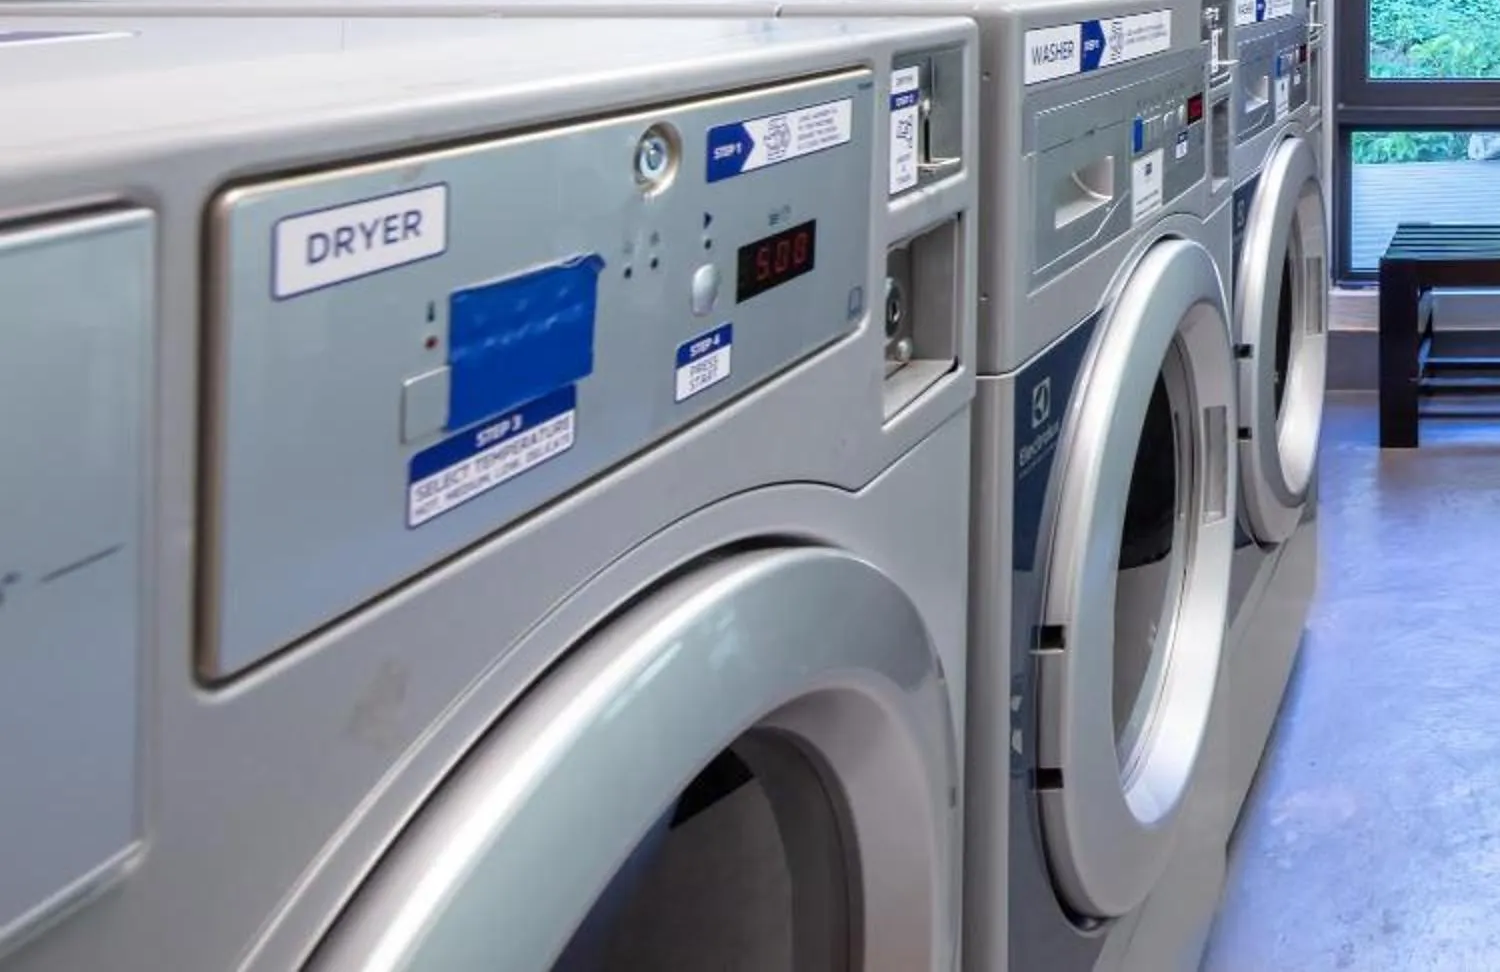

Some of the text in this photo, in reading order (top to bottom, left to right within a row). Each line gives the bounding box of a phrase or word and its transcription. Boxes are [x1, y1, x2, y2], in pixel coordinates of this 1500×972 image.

[1031, 40, 1075, 65] WASHER
[713, 143, 736, 160] STEP
[306, 209, 423, 266] DRYER
[690, 337, 713, 357] STEP
[475, 413, 523, 449] STEP 3
[415, 416, 572, 502] SELECT TEMPERATURE
